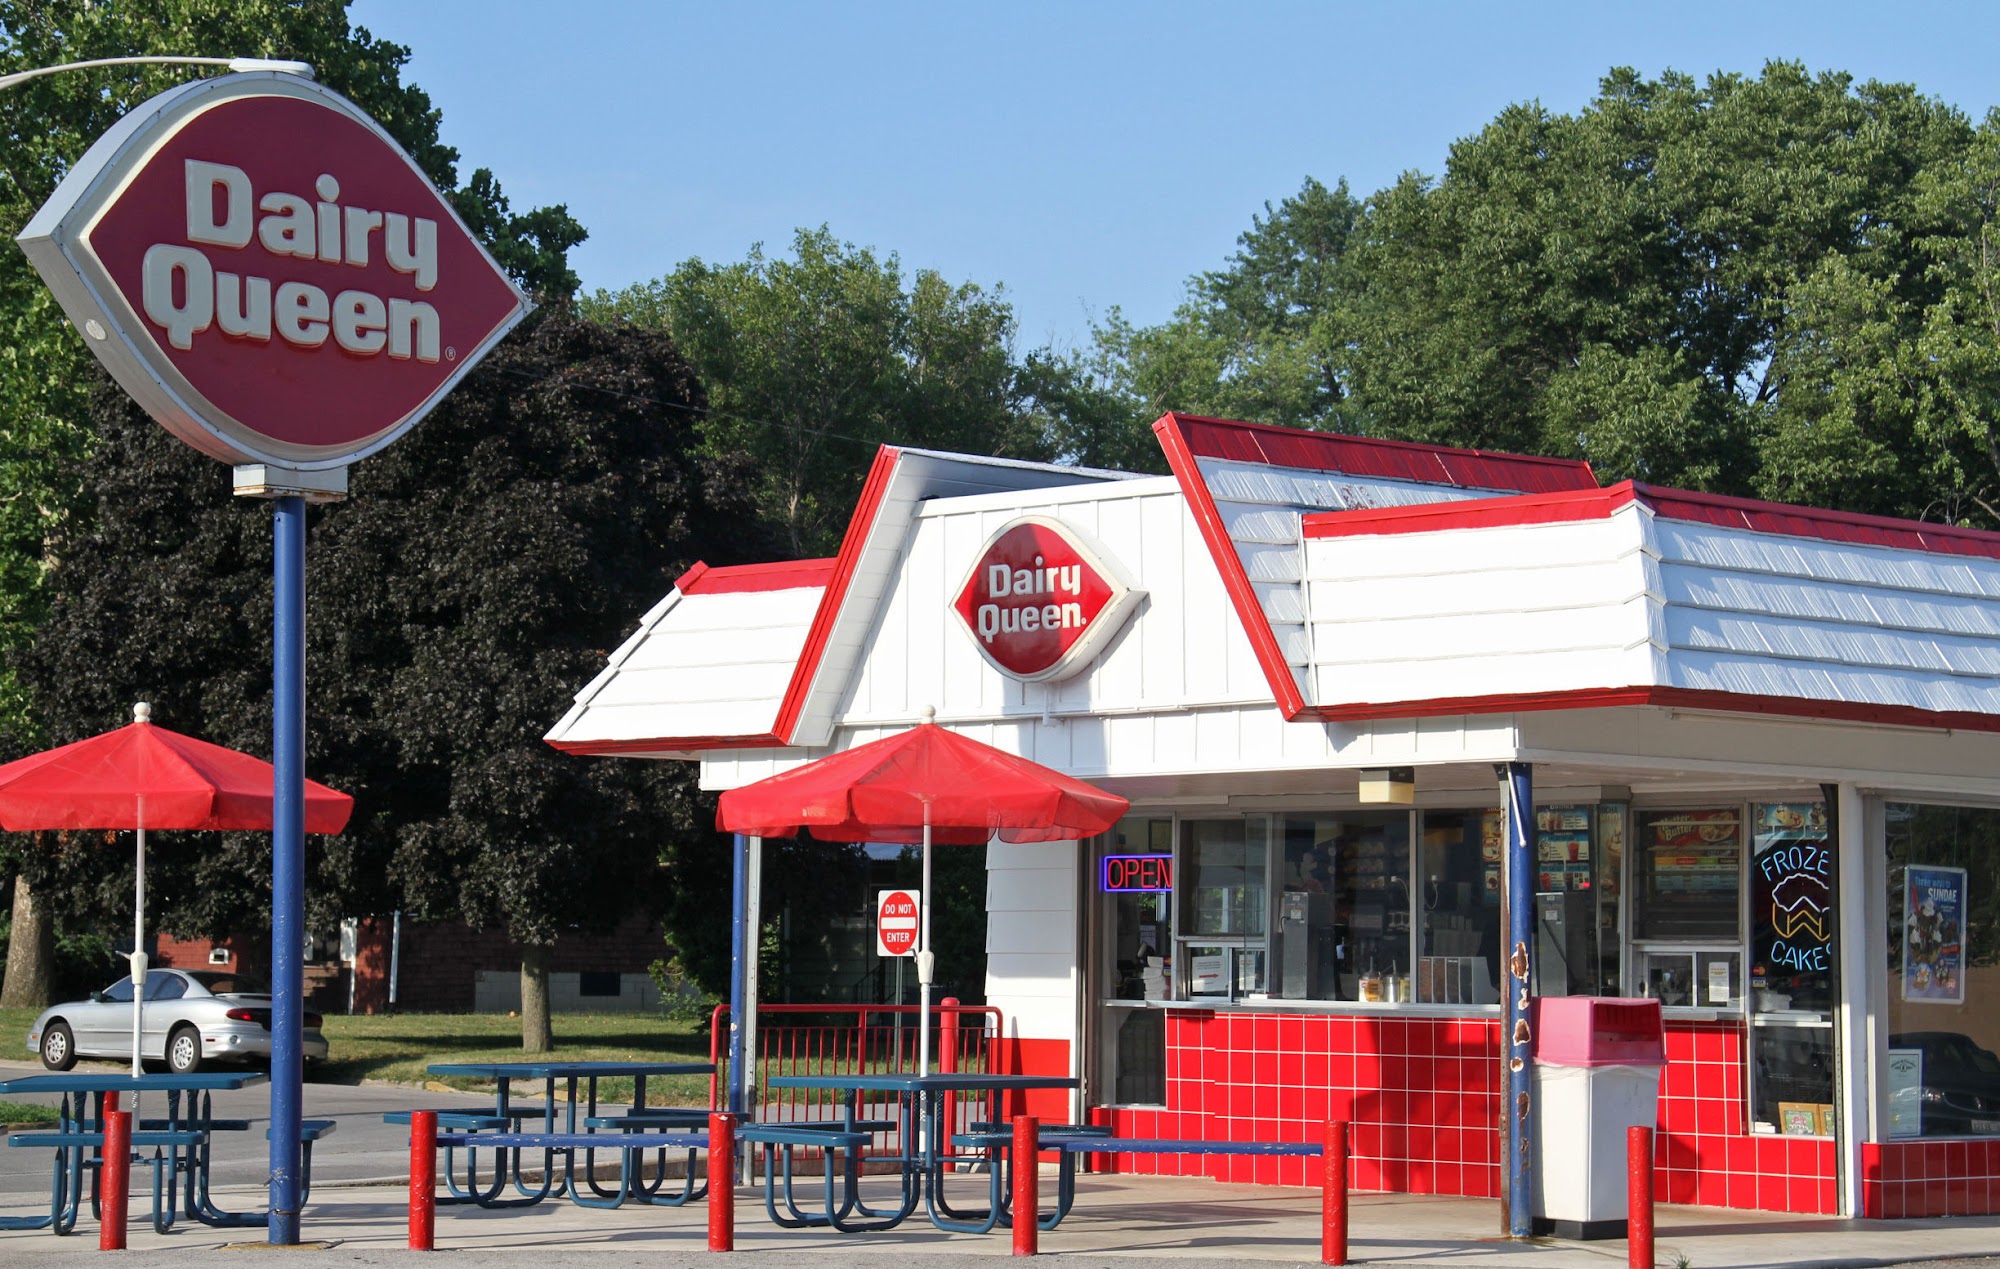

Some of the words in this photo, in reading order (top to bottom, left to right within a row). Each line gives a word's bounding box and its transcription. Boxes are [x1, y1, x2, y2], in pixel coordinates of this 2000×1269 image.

[185, 158, 438, 290] Dairy
[142, 243, 441, 363] Queen
[988, 555, 1081, 598] Dairy
[977, 602, 1082, 643] Queen
[1107, 858, 1172, 889] OPEN
[885, 904, 896, 914] DO
[898, 903, 912, 914] NOT
[1927, 887, 1957, 903] SUNDAE
[886, 932, 910, 943] ENTER
